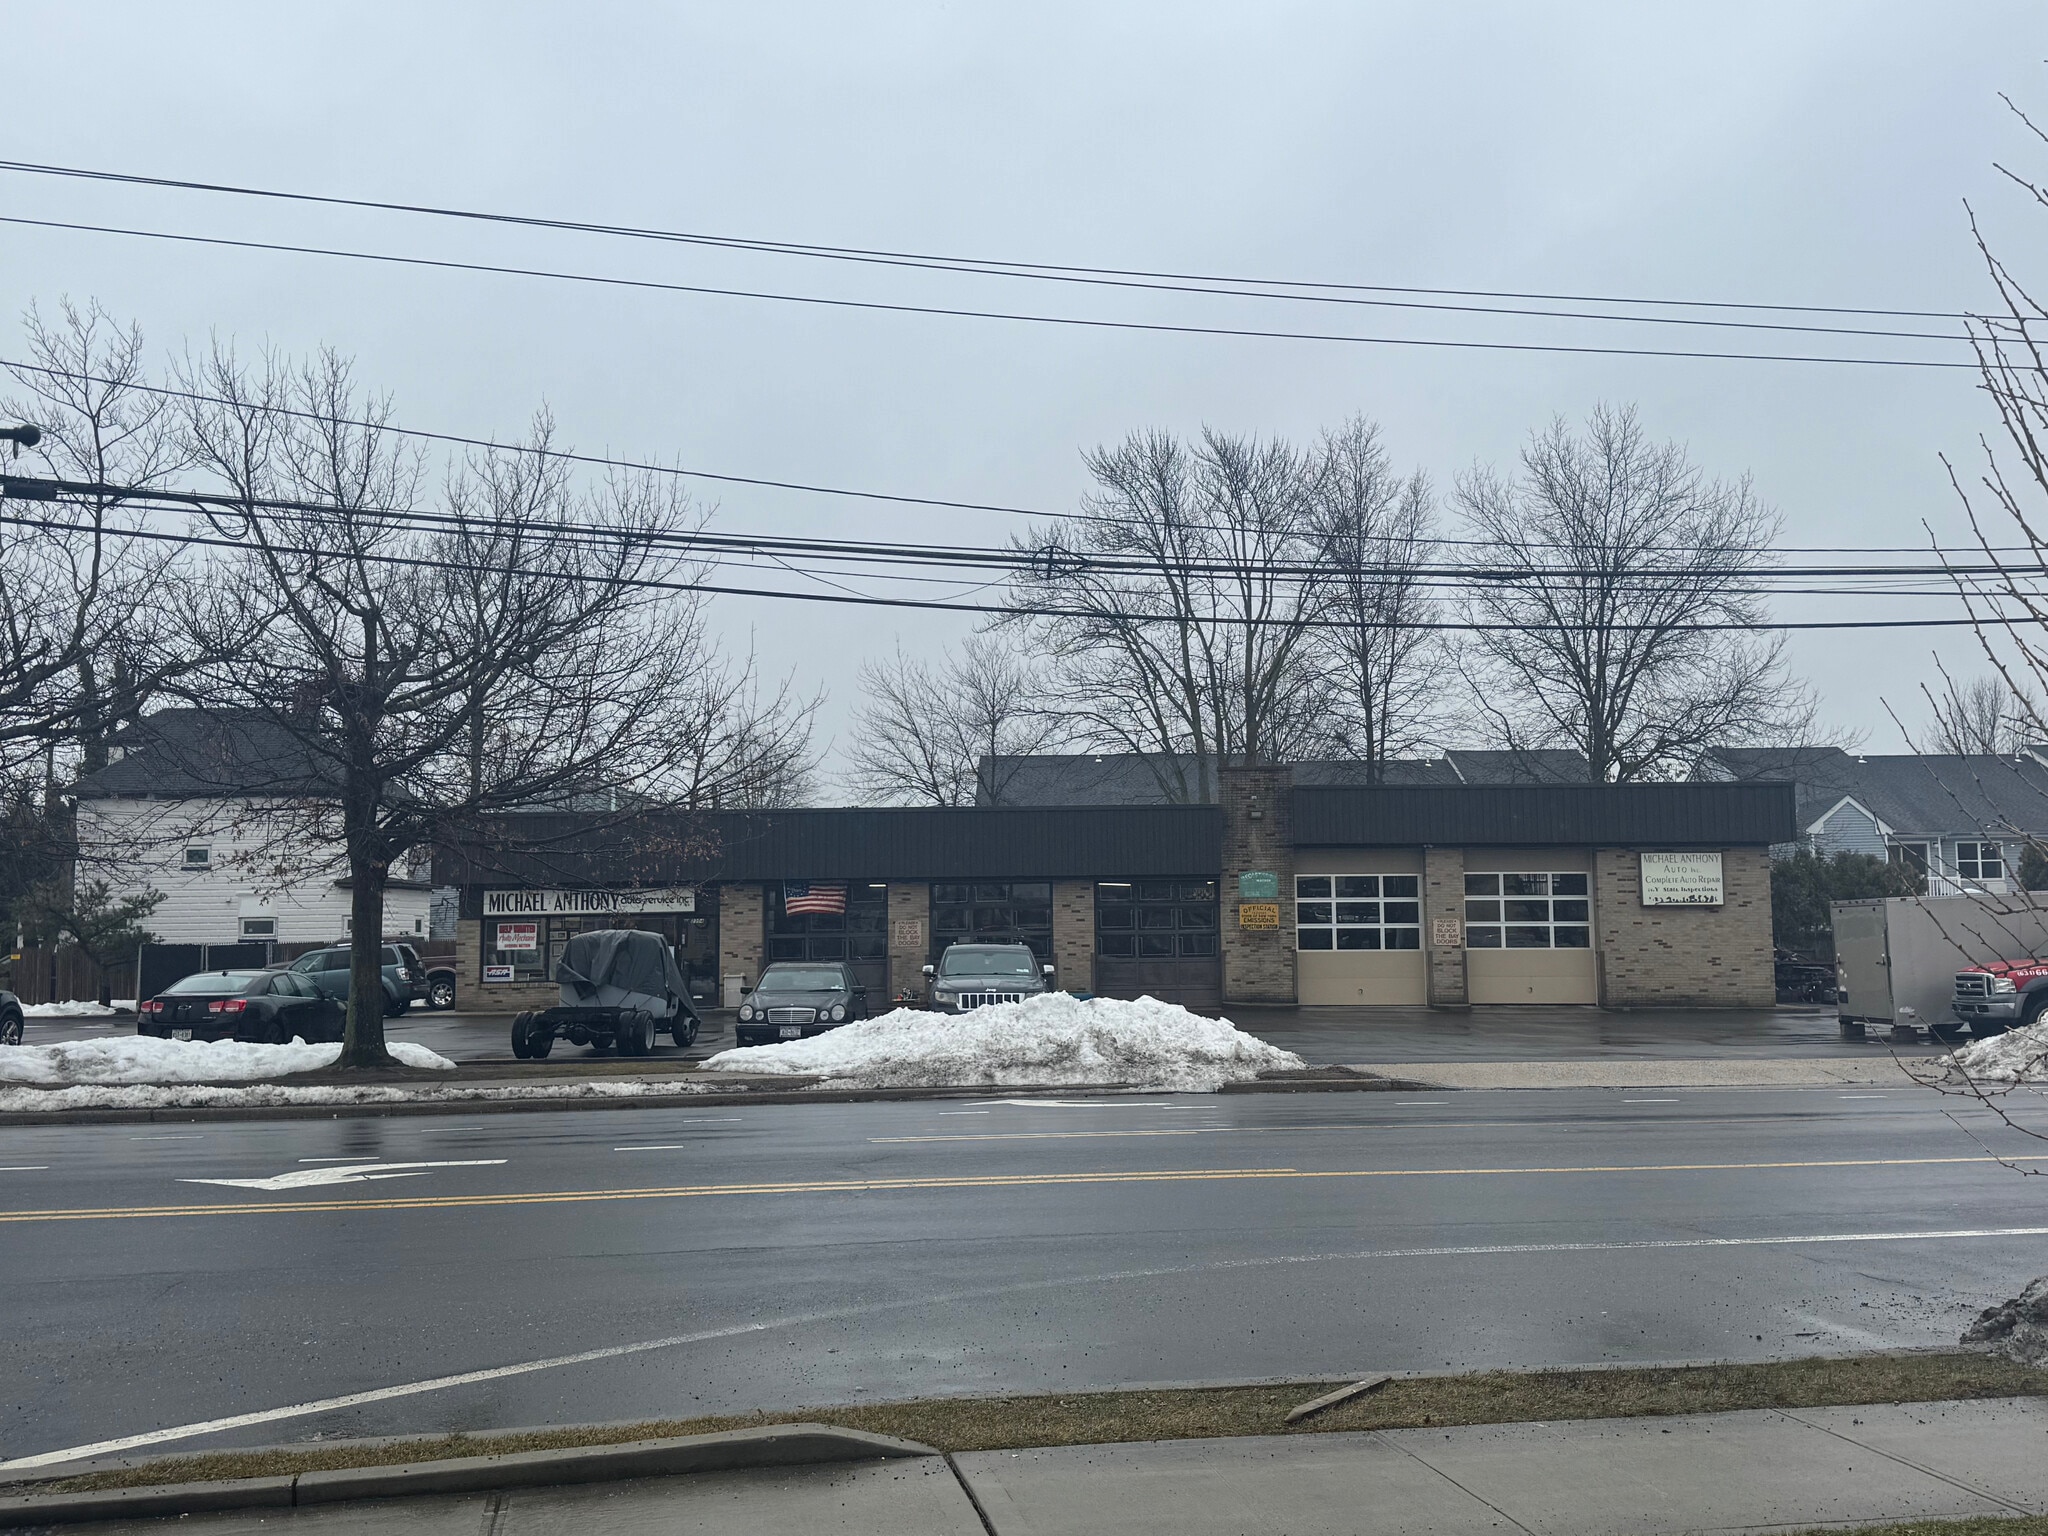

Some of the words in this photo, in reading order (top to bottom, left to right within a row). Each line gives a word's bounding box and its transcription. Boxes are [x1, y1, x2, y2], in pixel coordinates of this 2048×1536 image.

[1643, 854, 1678, 863] MICHAEL
[1680, 854, 1719, 863] ANTHONY
[489, 893, 547, 912] MICHAEL
[554, 892, 619, 911] ANTHONY
[1243, 905, 1276, 914] OFFICIAL
